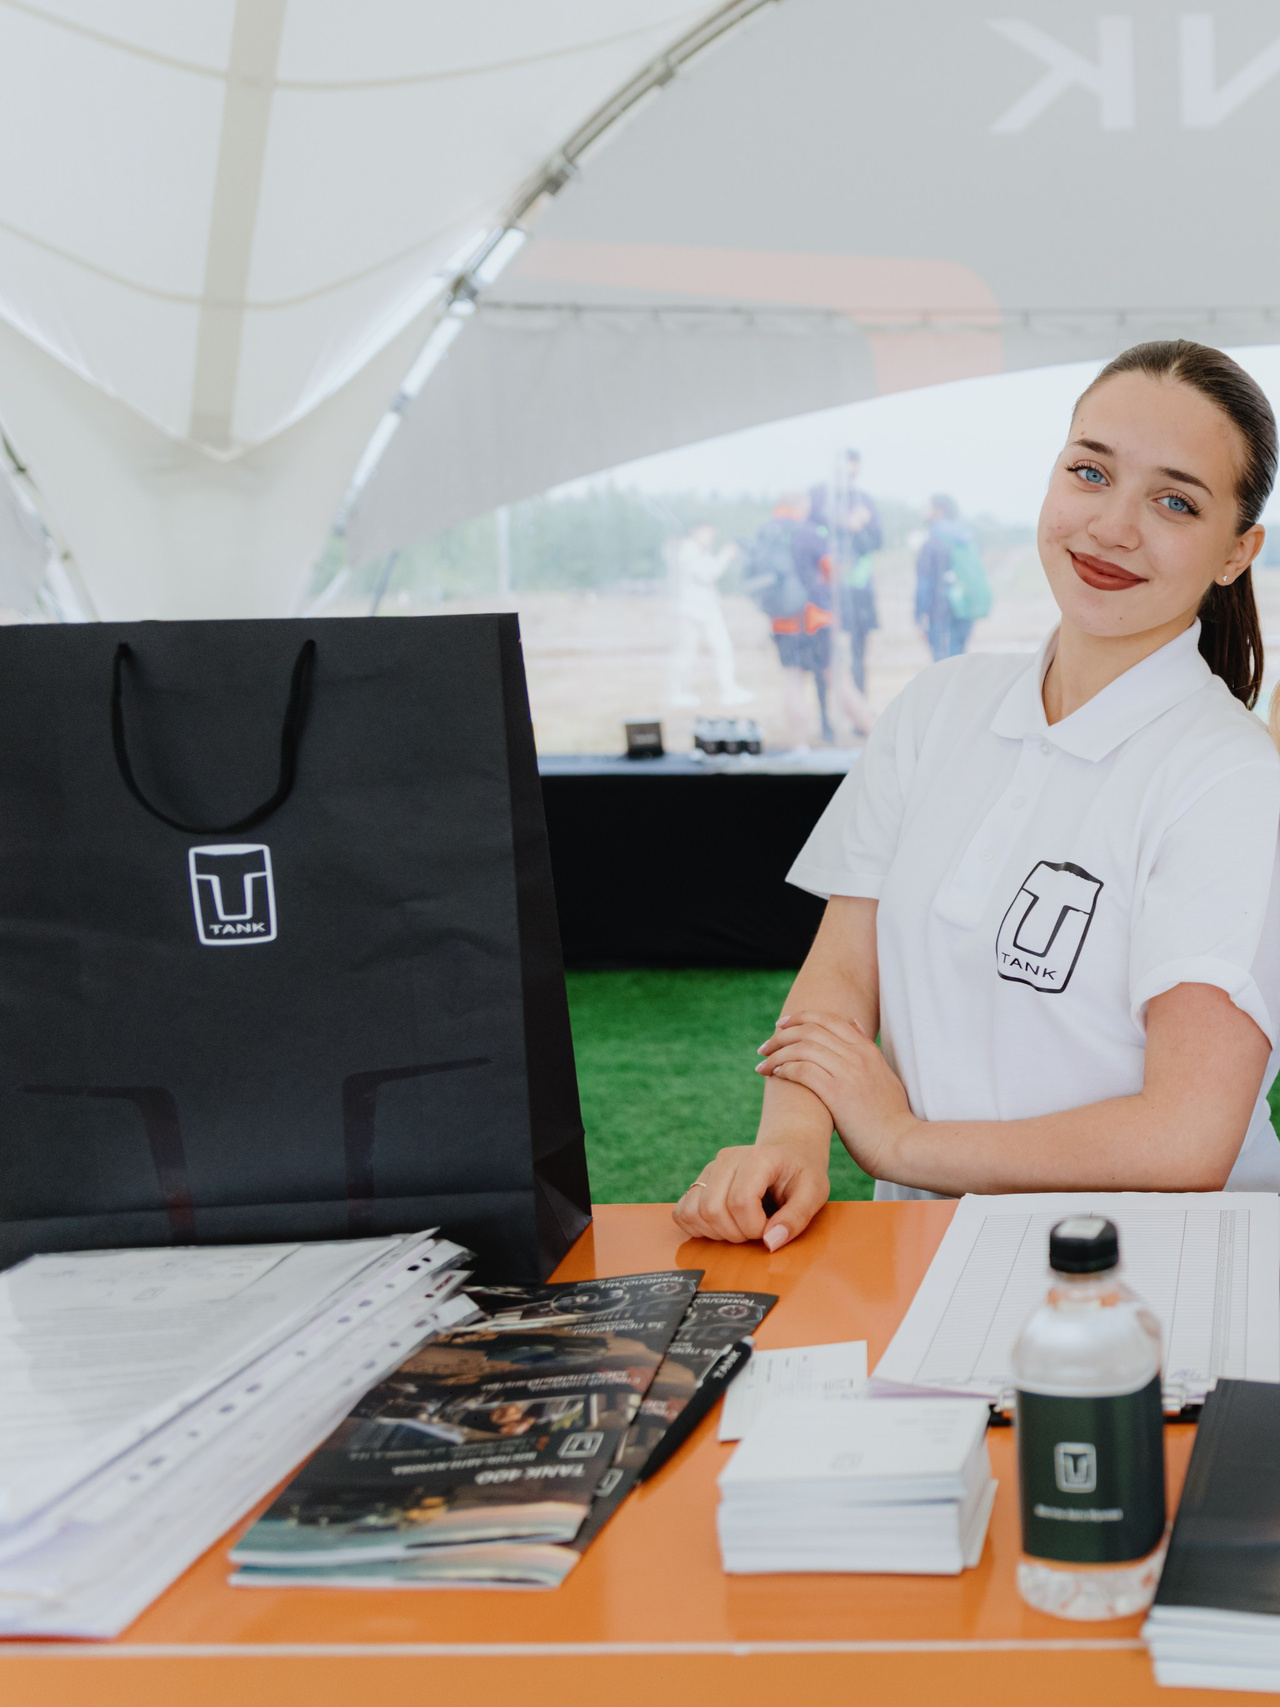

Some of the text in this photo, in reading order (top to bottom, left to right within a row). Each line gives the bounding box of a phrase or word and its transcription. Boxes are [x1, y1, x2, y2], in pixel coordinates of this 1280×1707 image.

[209, 921, 267, 936] TANK
[1001, 951, 1057, 981] TANK
[713, 1349, 742, 1379] TANK
[474, 1462, 585, 1486] TANK 400
